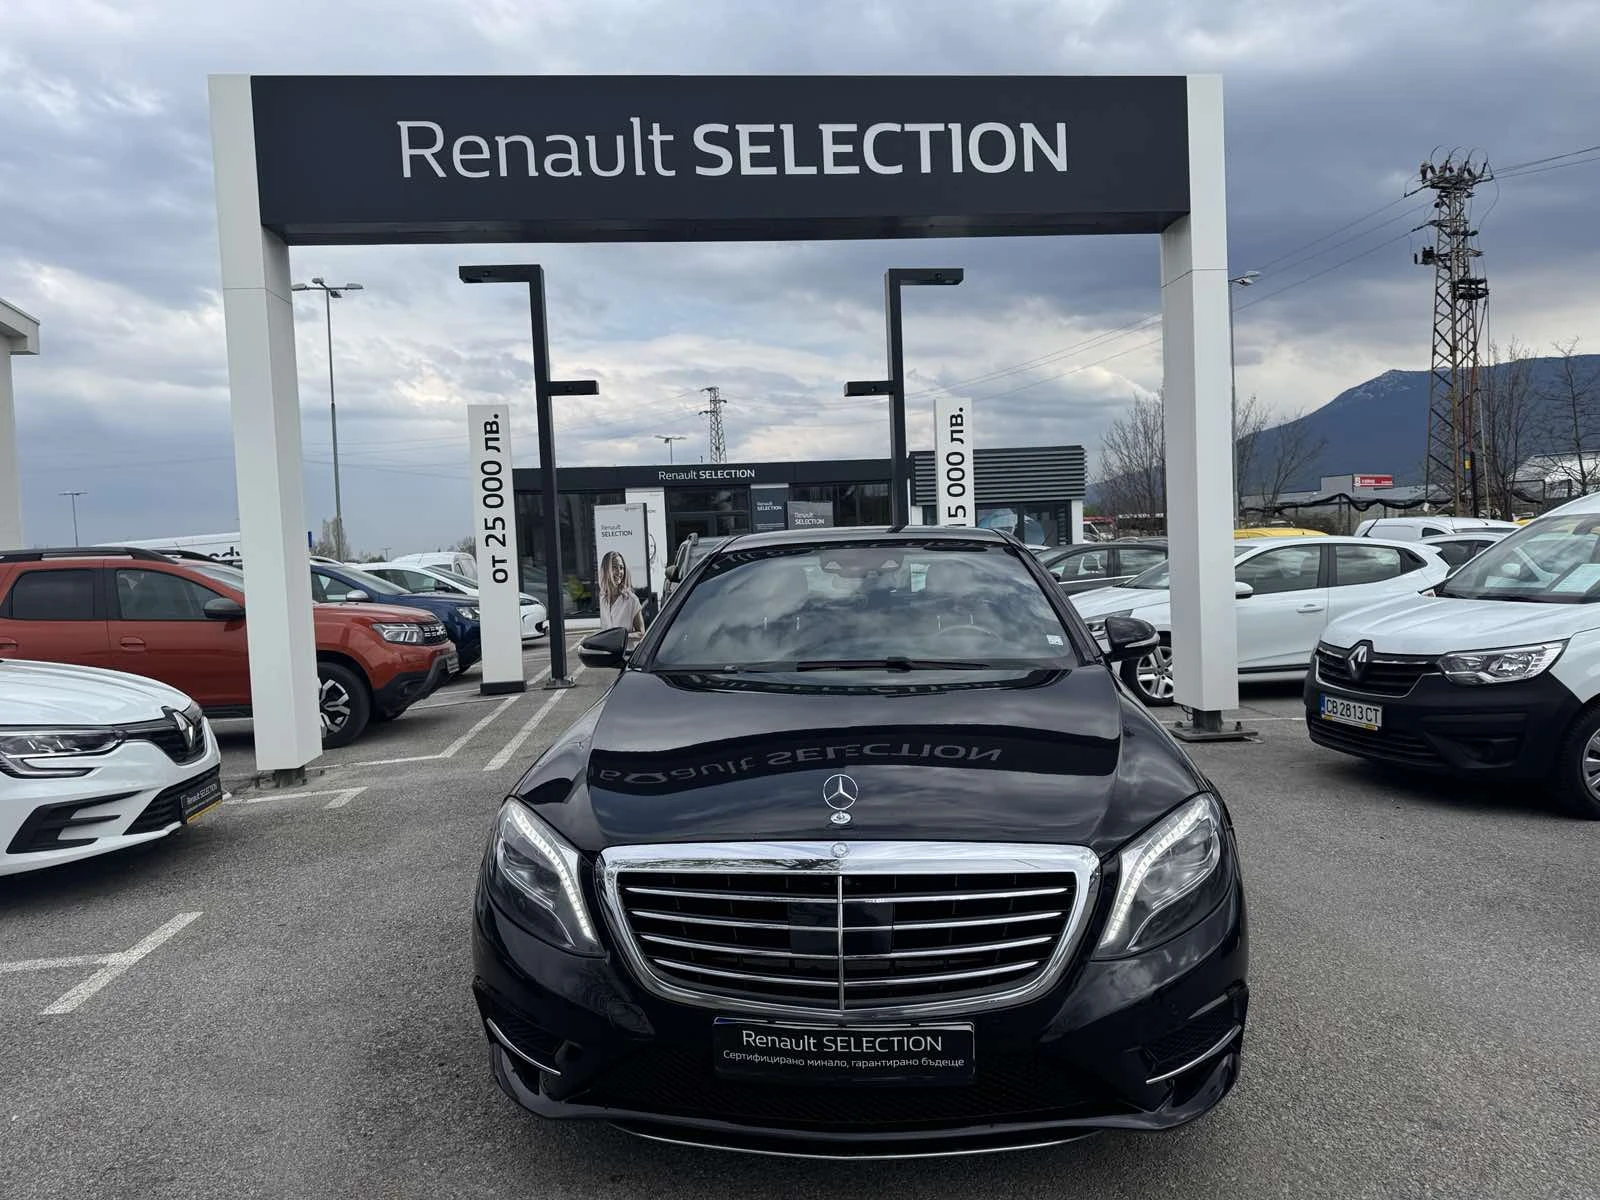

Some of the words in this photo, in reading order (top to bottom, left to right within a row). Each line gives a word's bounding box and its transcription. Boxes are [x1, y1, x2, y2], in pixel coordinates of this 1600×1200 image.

[397, 117, 677, 178] Renault
[693, 122, 1068, 177] SELECTION
[484, 413, 501, 453] лв.
[950, 407, 965, 445] лв.
[481, 460, 504, 509] 000
[658, 471, 698, 480] Renault
[699, 469, 756, 479] SELECTION
[946, 451, 966, 498] 000
[484, 516, 507, 547] 25
[492, 555, 509, 584] от
[1340, 702, 1364, 720] 2813
[742, 1030, 818, 1051] Renault
[823, 1036, 942, 1053] SELECTION
[723, 1050, 805, 1066] Сертифицирано
[807, 1058, 849, 1068] минало,
[851, 1057, 919, 1068] гарантирано
[921, 1056, 965, 1067] бъдеще
